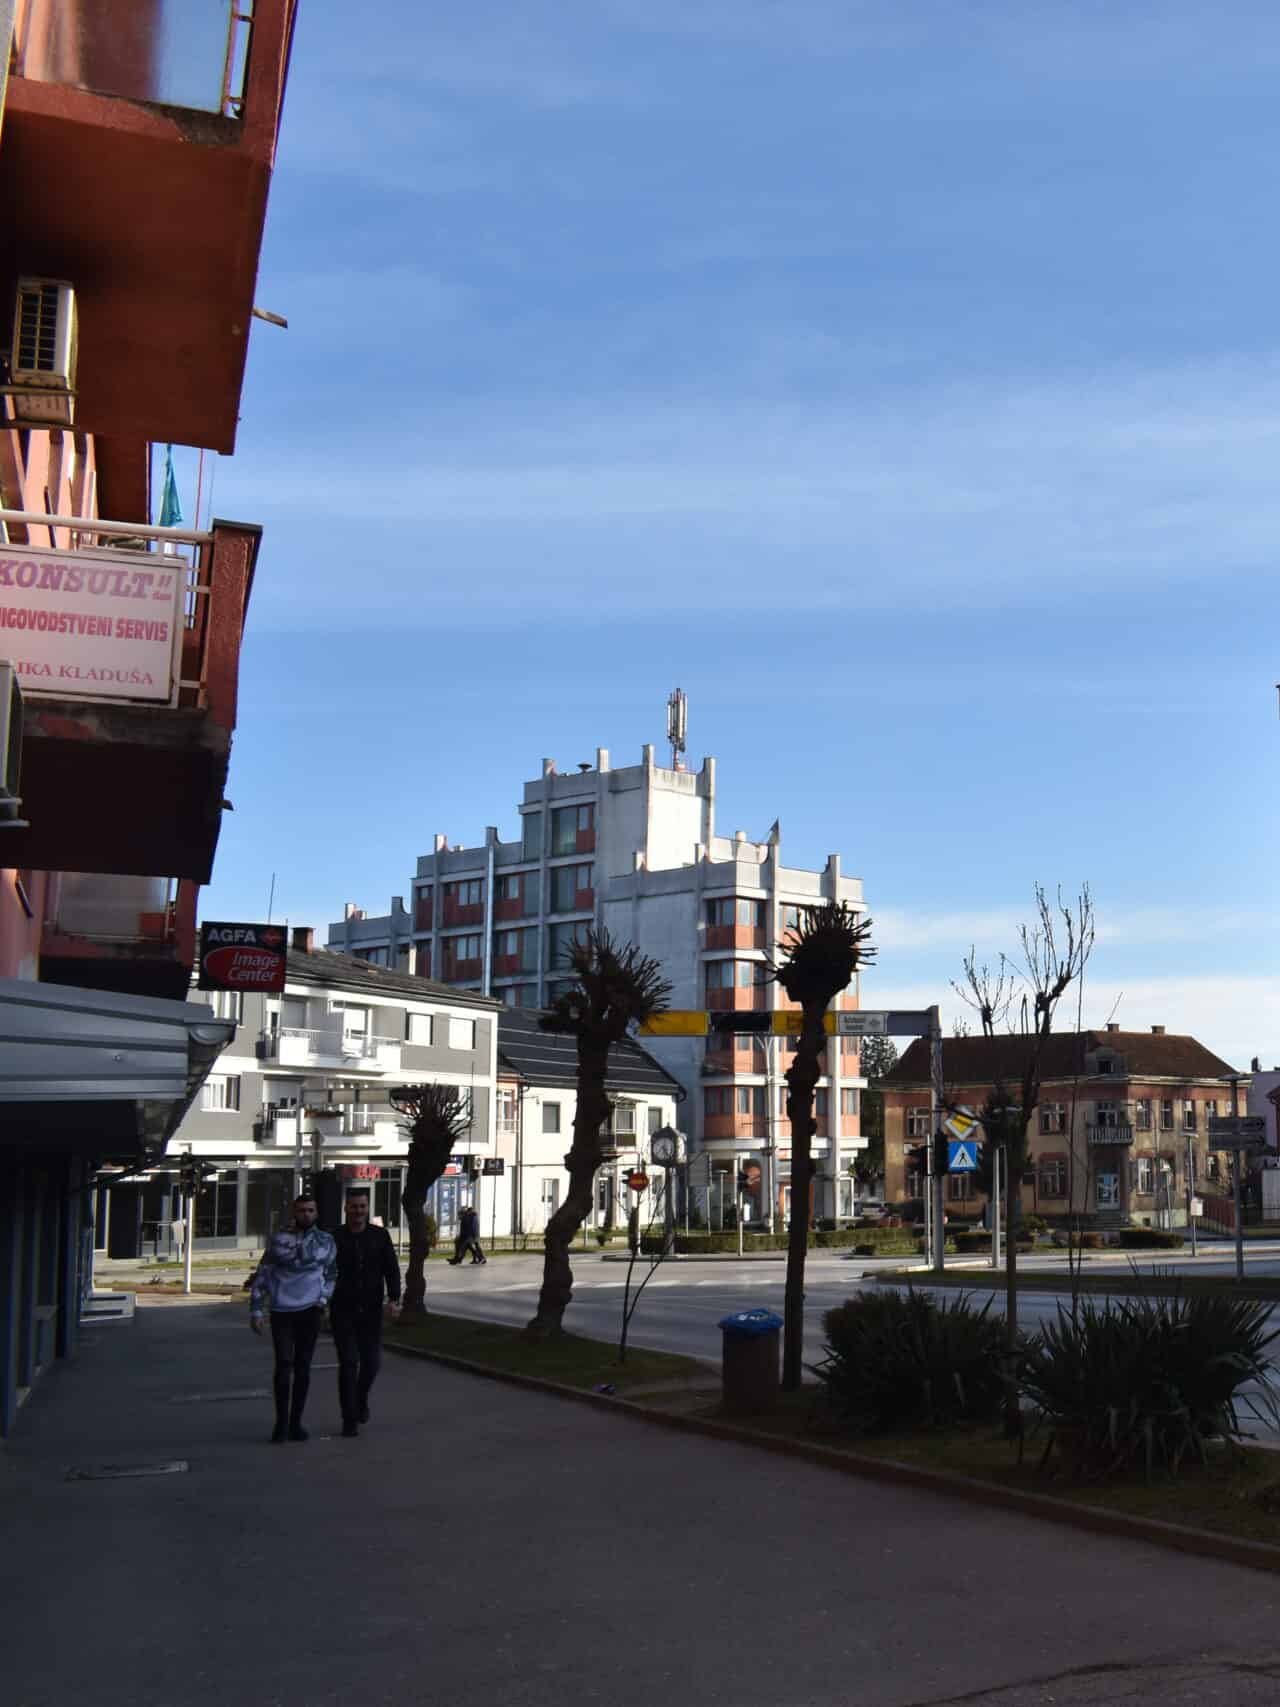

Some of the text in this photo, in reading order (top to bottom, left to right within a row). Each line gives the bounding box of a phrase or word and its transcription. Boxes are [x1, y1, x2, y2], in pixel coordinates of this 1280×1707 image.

[0, 606, 169, 642] IGOVODSTVENI SERVIS
[58, 664, 154, 684] KLADUŠA
[207, 928, 257, 943] AGFA
[232, 951, 280, 970] Image
[226, 967, 278, 983] Center
